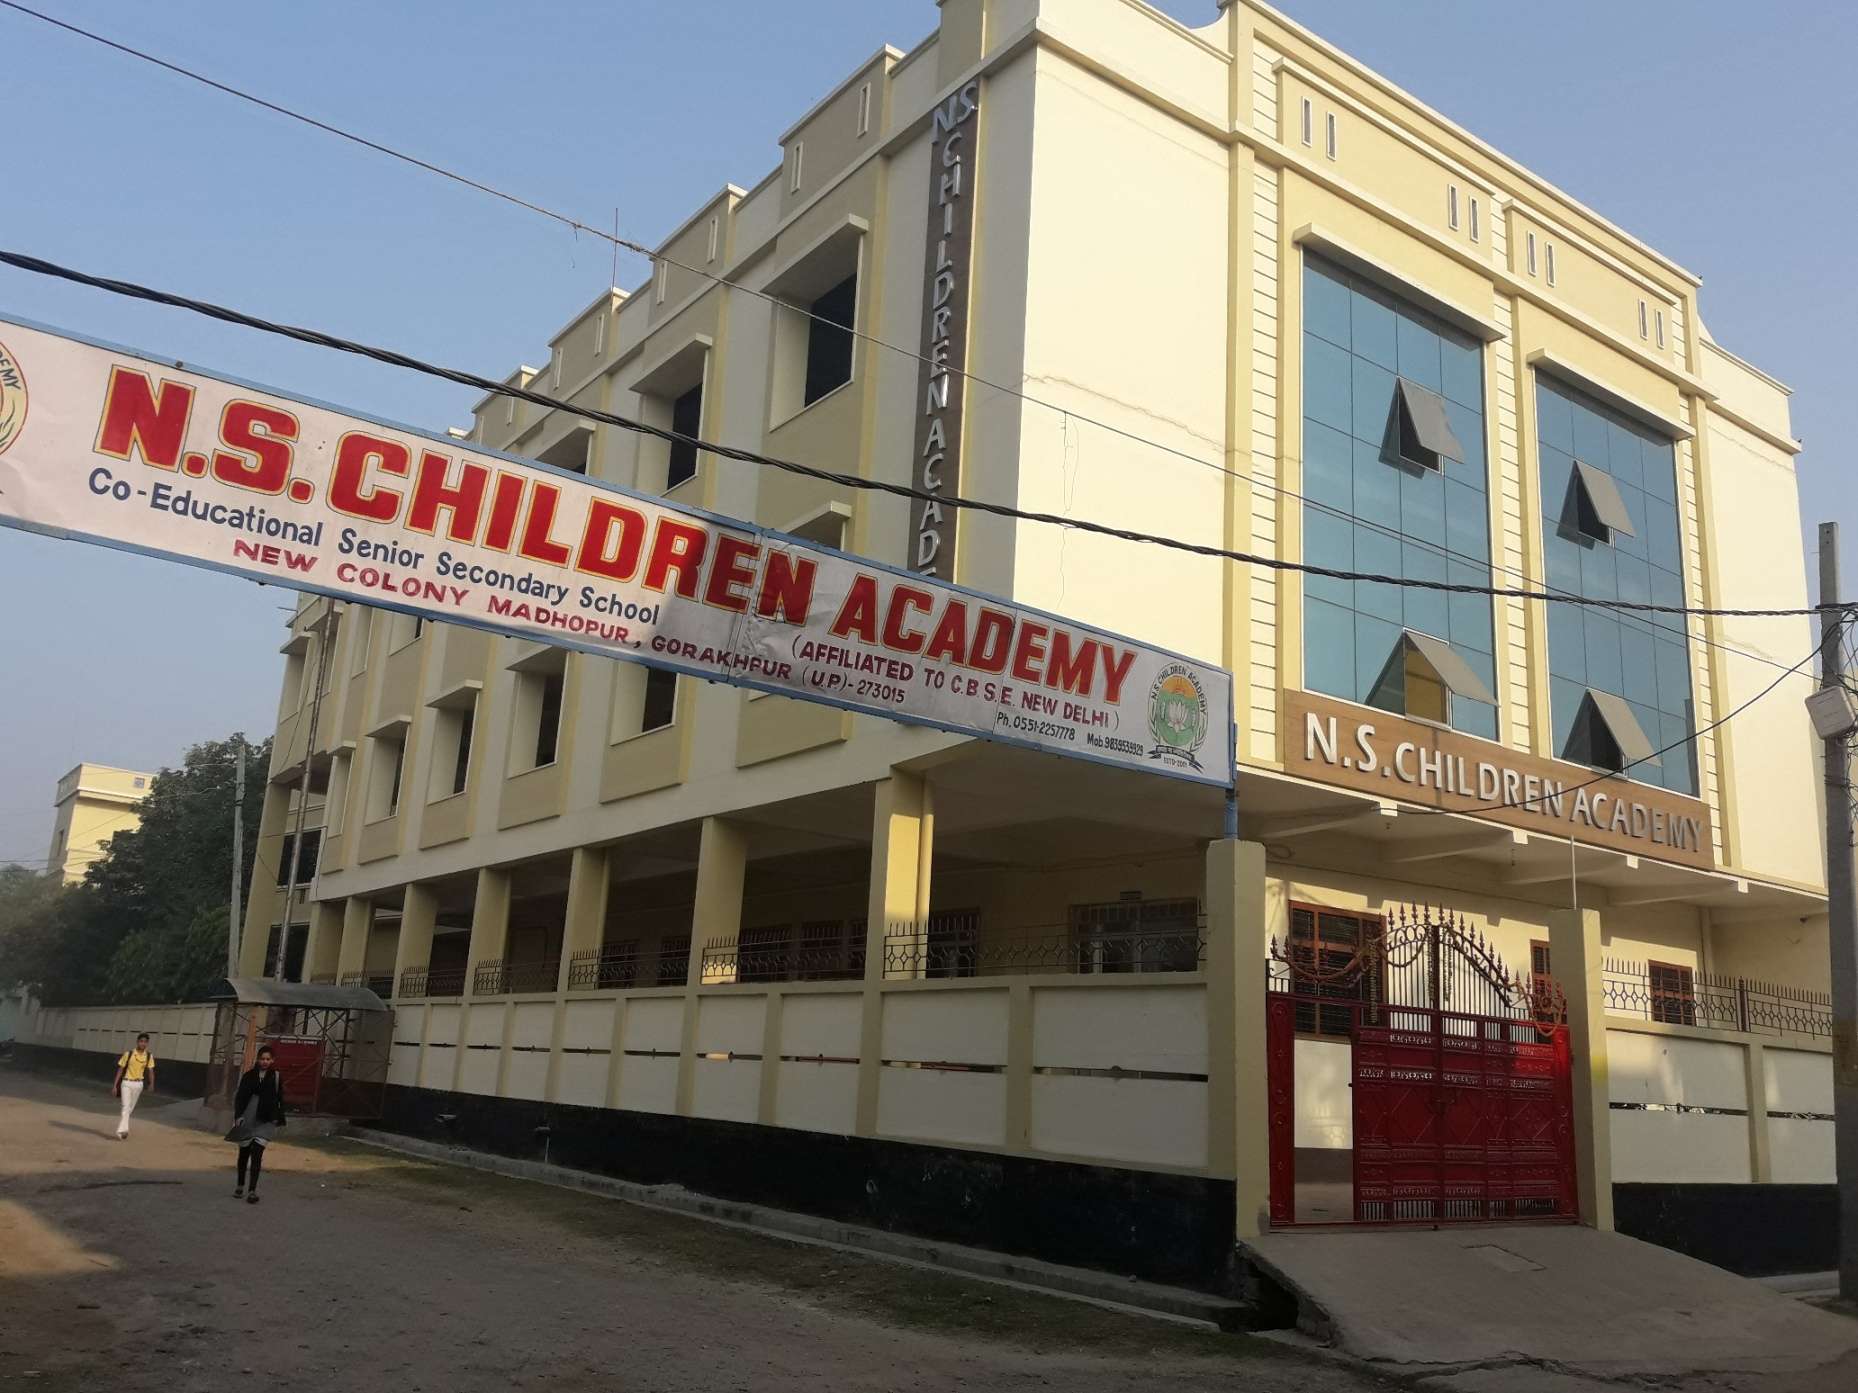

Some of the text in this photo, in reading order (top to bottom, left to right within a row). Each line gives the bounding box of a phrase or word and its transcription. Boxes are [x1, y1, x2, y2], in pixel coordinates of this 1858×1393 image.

[927, 131, 962, 416] CHILDREN
[88, 467, 660, 626] Co-Educational Senior Secondary School
[326, 430, 819, 627] CHILDREN
[827, 572, 1137, 706] ACADEMY
[918, 418, 946, 576] ACAD
[232, 539, 318, 573] NEW
[337, 563, 469, 606] COLONY
[651, 635, 792, 680] GORAKHPUR
[792, 634, 914, 682] (AFFILIATED
[925, 668, 945, 690] TO
[1022, 691, 1058, 717] NEW
[1569, 787, 1701, 853] ACADEMY
